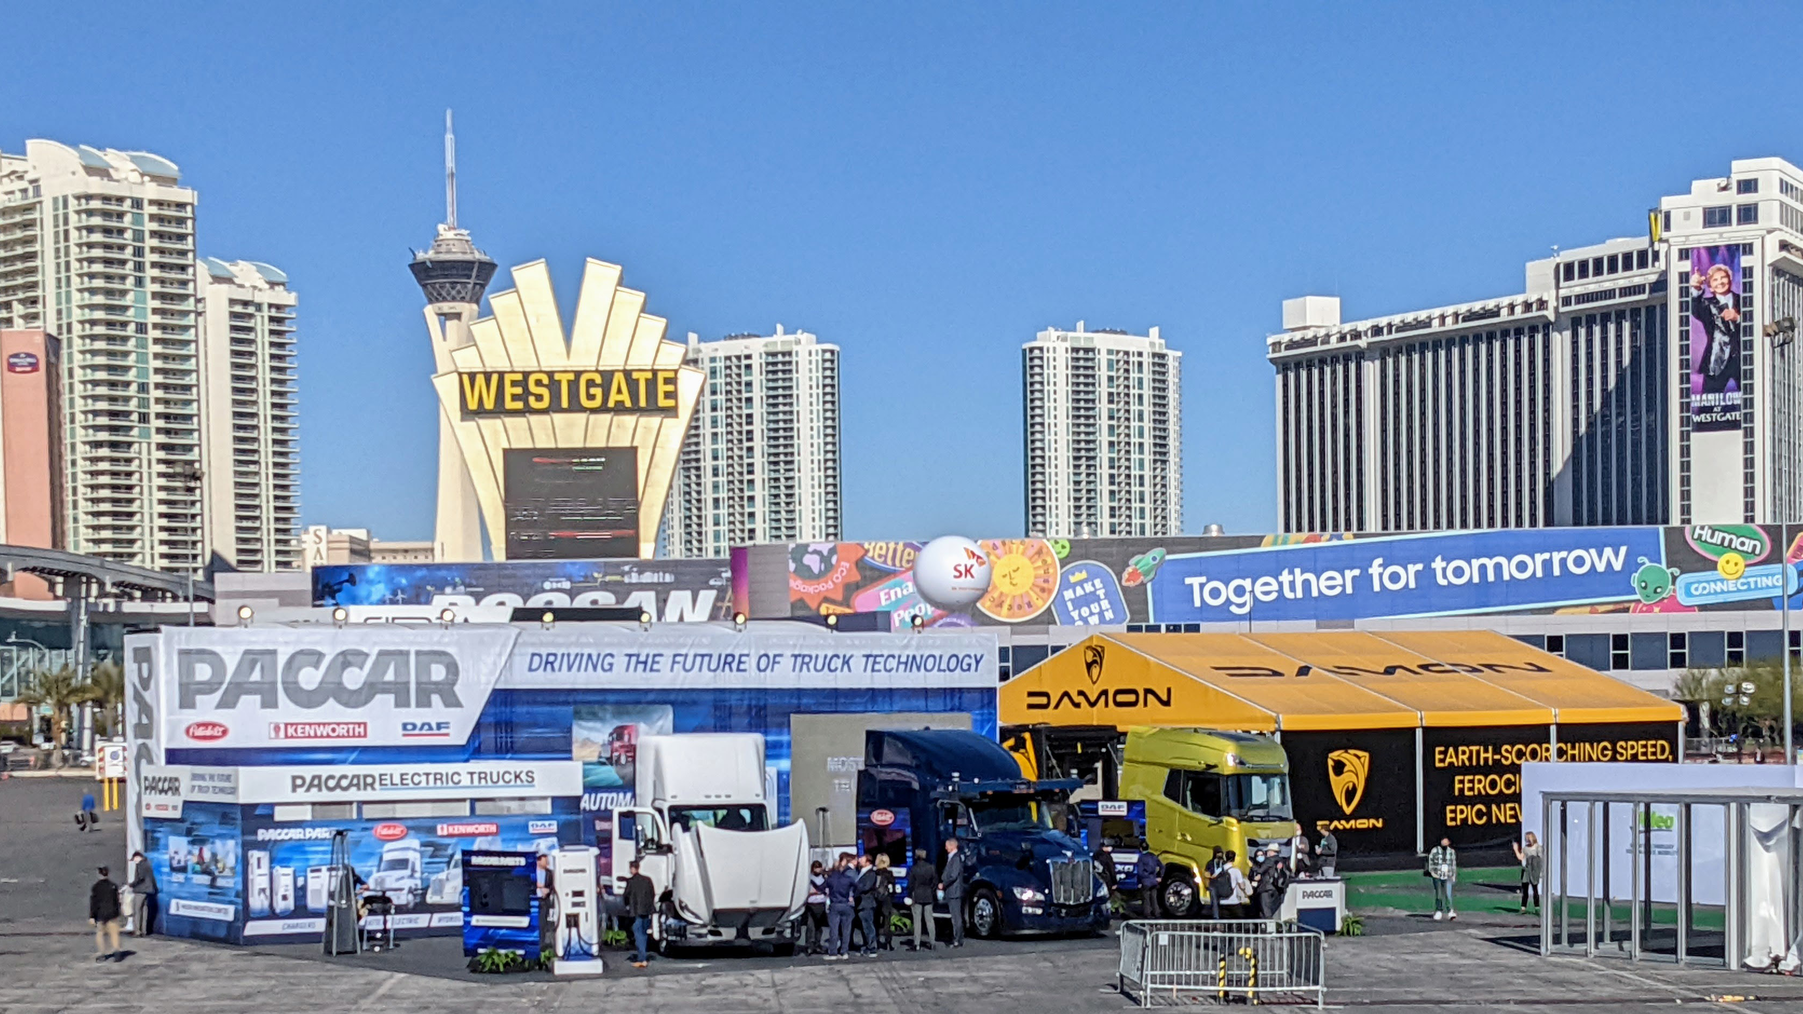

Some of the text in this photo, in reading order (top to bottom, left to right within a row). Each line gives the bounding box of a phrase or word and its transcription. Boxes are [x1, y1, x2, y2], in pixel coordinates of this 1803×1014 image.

[461, 371, 676, 411] WESTGATE
[1691, 391, 1742, 407] MANILOW
[1692, 411, 1742, 423] WESTGATE
[313, 529, 324, 566] SA
[1693, 525, 1762, 555] Human
[953, 564, 975, 579] SK
[1185, 545, 1627, 615] Together for tomorrow
[879, 581, 914, 606] Ena
[1062, 578, 1103, 601] MAKE
[1690, 574, 1783, 596] CONNECTING
[1070, 599, 1111, 621] YOUR
[527, 652, 984, 673] DRIVING THE FUTURE OF TRUCK TECHNOLOGY
[177, 648, 464, 710] PACCAR
[1026, 687, 1172, 711] DAMON
[286, 723, 366, 737] KENWORTH
[402, 722, 451, 732] DAF
[1434, 739, 1674, 768] EARTH-SCORCHING SPEED,
[291, 769, 536, 794] PACCAR ELECTRIC TRUCKS
[1454, 773, 1522, 797] FEROCI
[1446, 804, 1488, 826] EPIC
[1302, 890, 1333, 899] PACCAR
